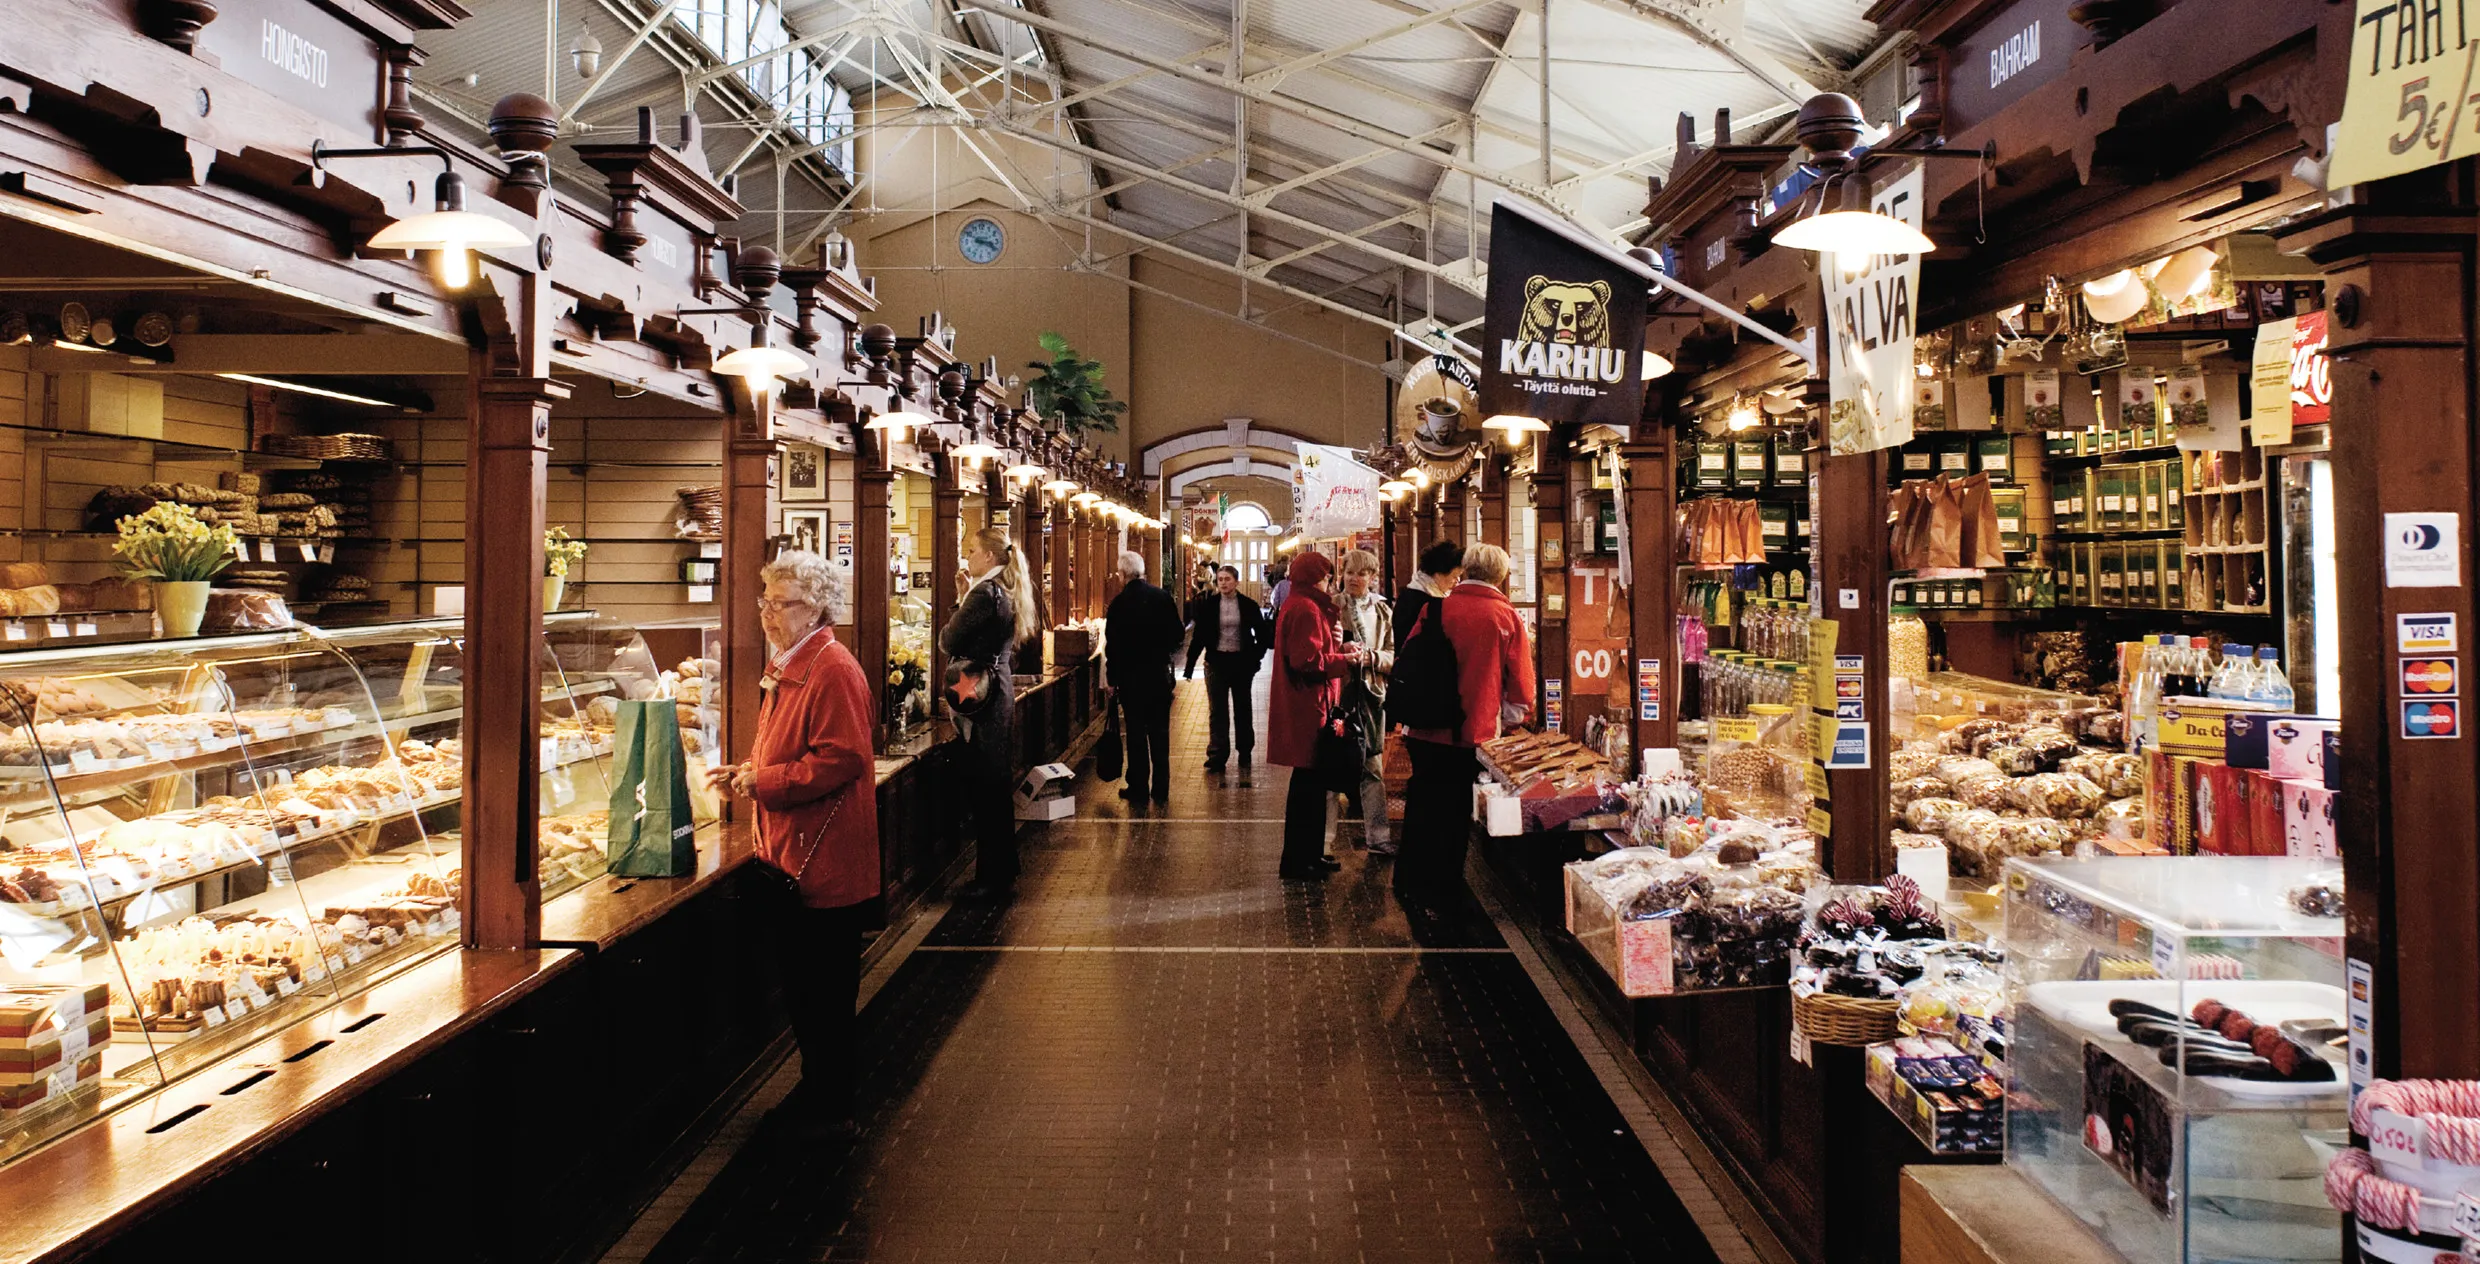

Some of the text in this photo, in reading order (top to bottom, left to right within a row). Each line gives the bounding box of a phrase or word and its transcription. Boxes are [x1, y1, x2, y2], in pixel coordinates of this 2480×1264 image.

[262, 18, 328, 89] HONGISTO
[1990, 19, 2040, 89] BAHRAM
[1500, 338, 1625, 384] KARHU
[1522, 379, 1597, 397] Täyttä olutta
[1405, 440, 1478, 482] ERIKOISKAHVEJA
[1293, 487, 1304, 534] DÖNER
[2410, 625, 2446, 639] VISA
